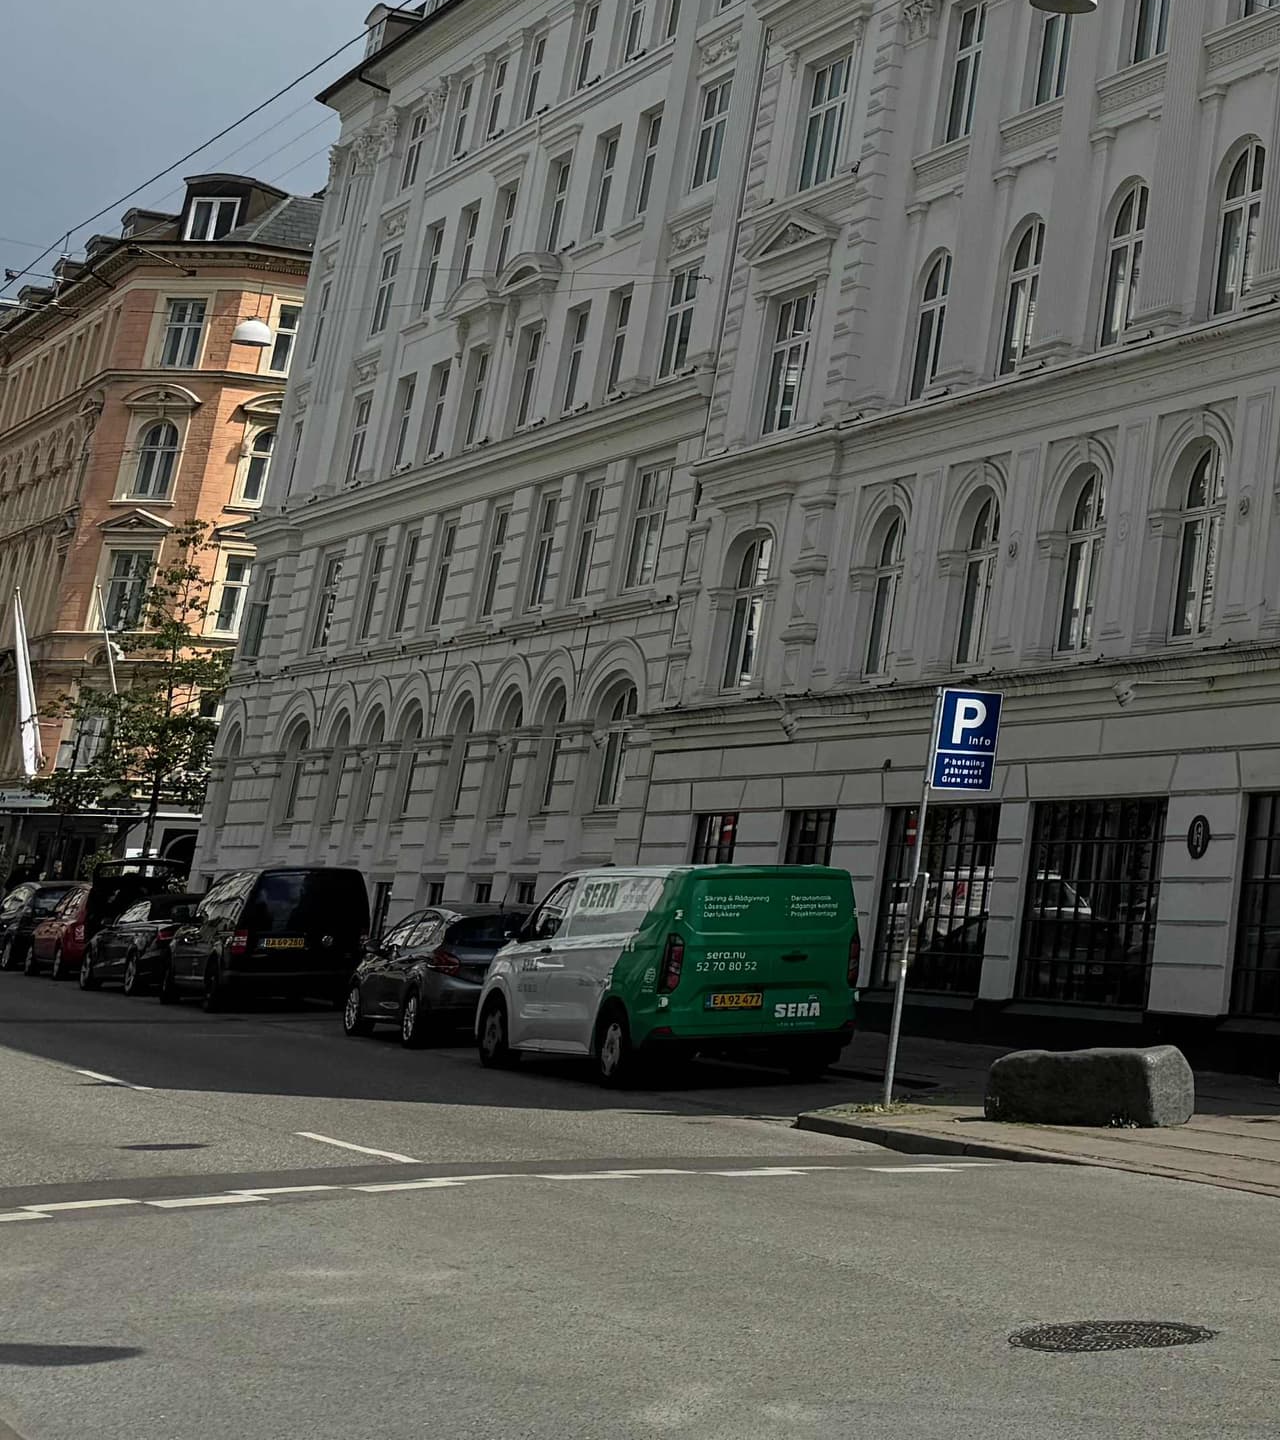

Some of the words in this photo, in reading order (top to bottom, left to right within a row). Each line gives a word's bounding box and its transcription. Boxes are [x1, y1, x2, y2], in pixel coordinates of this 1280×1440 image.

[952, 697, 987, 744] P
[968, 735, 992, 746] Info
[944, 758, 985, 767] P-betaling
[944, 767, 982, 775] påkrævet
[941, 775, 960, 783] Grøn
[580, 882, 620, 908] SERA
[706, 950, 746, 960] sera.nu
[696, 962, 710, 972] 52
[712, 962, 726, 971] 70
[728, 962, 742, 971] 80
[744, 961, 758, 971] 52
[712, 996, 727, 1008] EA
[728, 995, 742, 1007] 92
[742, 994, 761, 1006] 477
[774, 1002, 821, 1018] SERA
